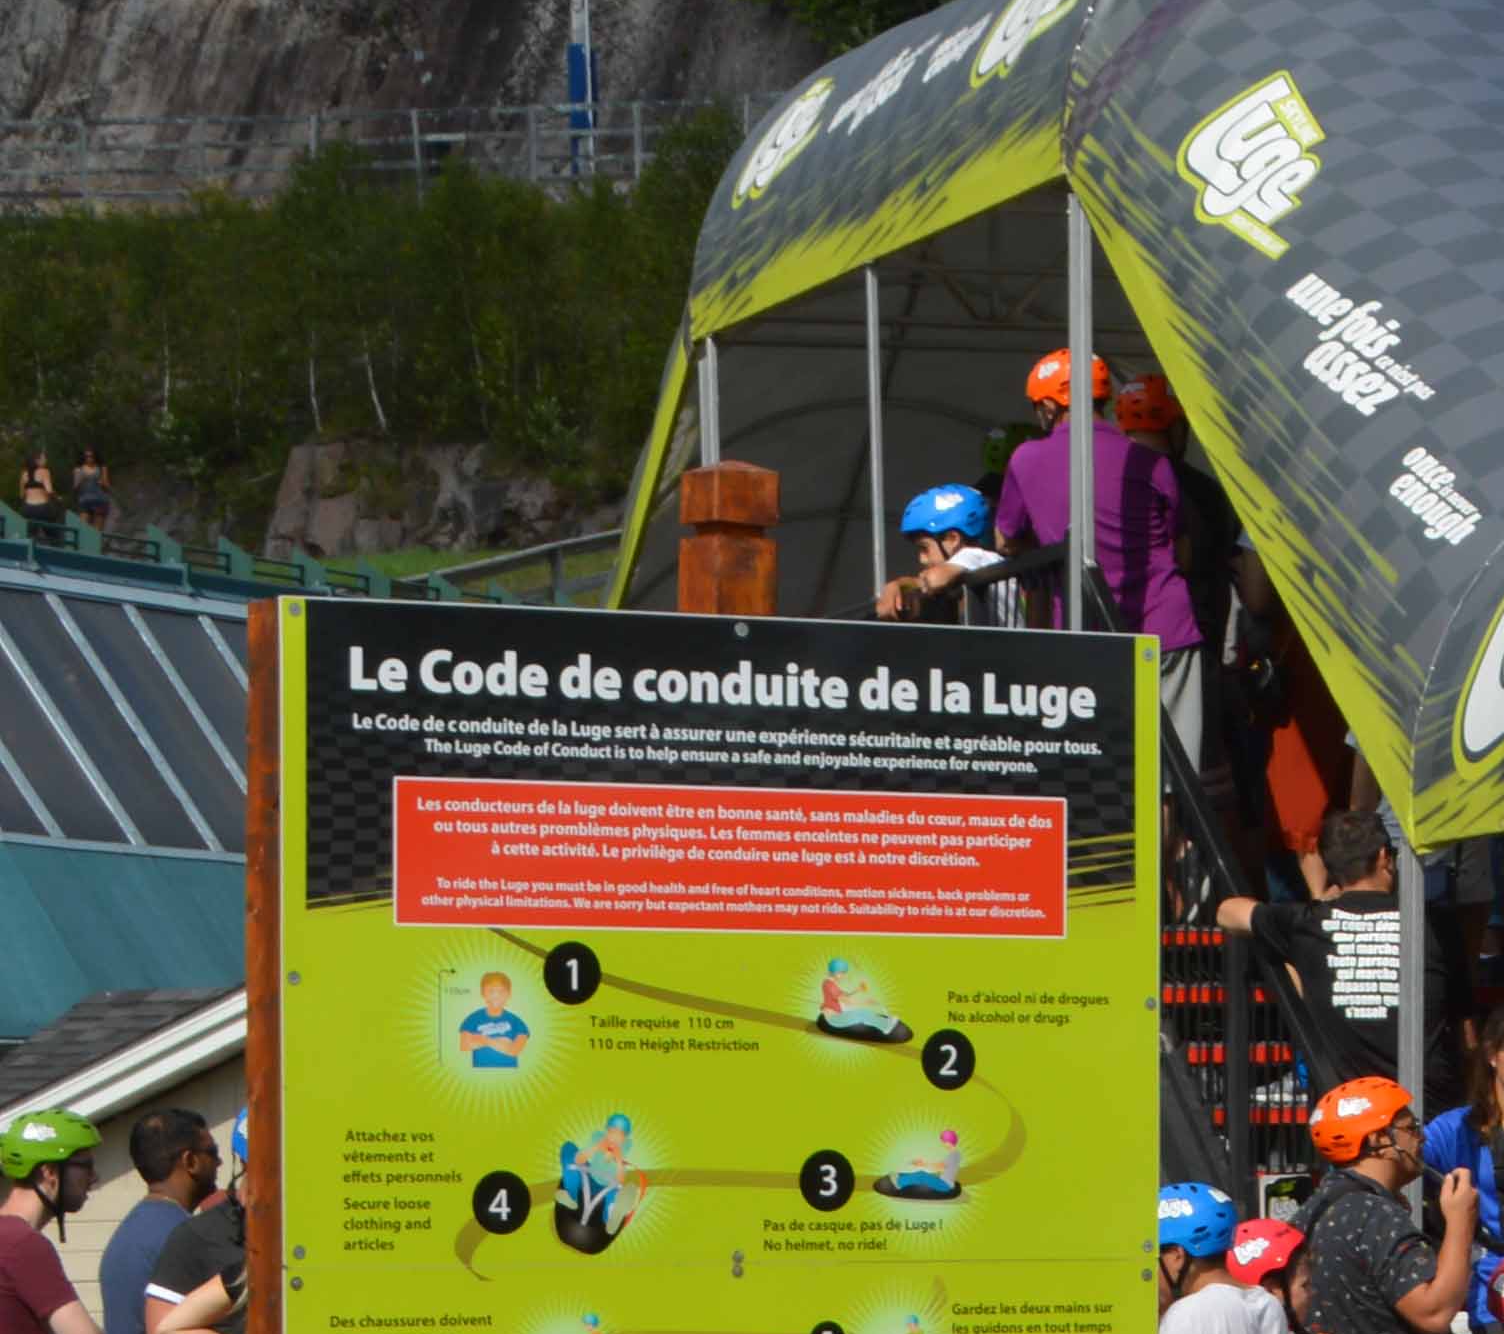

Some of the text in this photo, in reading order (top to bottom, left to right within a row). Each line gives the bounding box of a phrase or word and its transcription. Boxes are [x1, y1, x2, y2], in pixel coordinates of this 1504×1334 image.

[1285, 271, 1402, 361] une fois
[1303, 340, 1400, 417] assez
[1402, 445, 1457, 491] once
[1389, 471, 1484, 545] enough
[349, 645, 1096, 728] Le Code de conduite de la Luge
[352, 712, 372, 729] Le
[375, 713, 420, 731] Code
[423, 715, 445, 732] de
[527, 718, 550, 736] de
[552, 719, 568, 737] la
[571, 721, 612, 741] Luge
[615, 724, 647, 740] sert
[651, 722, 660, 740] à
[663, 728, 722, 742] assurer
[725, 731, 756, 743] une
[759, 729, 846, 749] expérience
[848, 730, 932, 750] sécuritaire
[934, 737, 951, 750] et
[953, 734, 1022, 756] agréable
[1024, 740, 1061, 756] pour
[1063, 739, 1102, 755] tous.
[566, 958, 578, 991] 1
[947, 990, 1109, 1007] Pas d'alcool ni de drogues
[947, 1010, 1069, 1027] No alcohol or drugs
[938, 1044, 958, 1076] 2
[345, 1129, 434, 1142] Attachez vos
[343, 1150, 433, 1163] vêtements et
[343, 1170, 462, 1186] effets personnels
[819, 1164, 838, 1196] 3
[343, 1196, 431, 1210] Secure loose
[488, 1188, 511, 1220] 4
[343, 1216, 431, 1233] clothing and
[343, 1238, 394, 1250] articles
